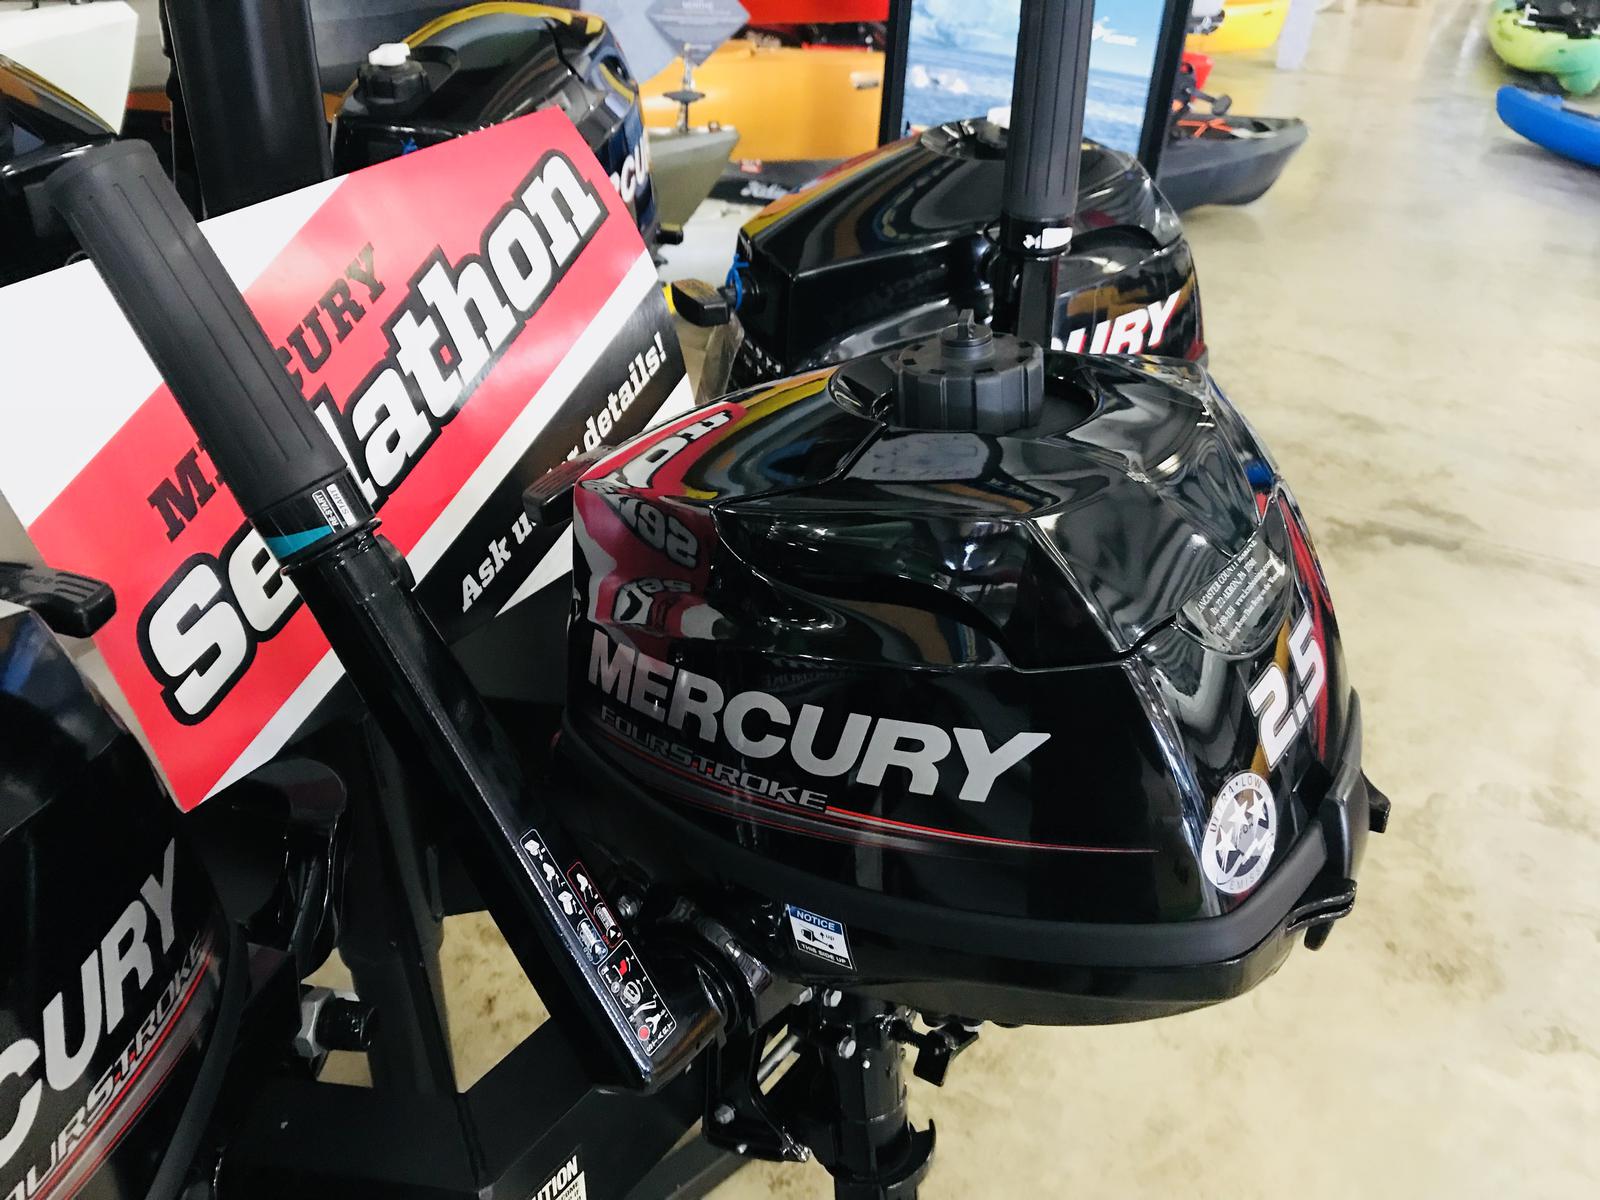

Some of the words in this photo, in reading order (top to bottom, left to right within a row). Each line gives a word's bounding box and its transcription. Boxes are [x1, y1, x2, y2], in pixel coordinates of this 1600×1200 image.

[1051, 289, 1181, 354] URY
[146, 241, 386, 543] MURY
[583, 331, 668, 453] details!
[143, 150, 605, 720] Selathon
[314, 493, 340, 526] RE-START
[331, 488, 350, 515] START
[462, 538, 512, 613] Ask
[588, 629, 1053, 803] MERCURY
[1247, 607, 1326, 772] 2.5
[600, 703, 829, 812] FOURSTROKE
[796, 910, 836, 931] NOTICE
[801, 943, 818, 954] THIS
[646, 1021, 674, 1052] START
